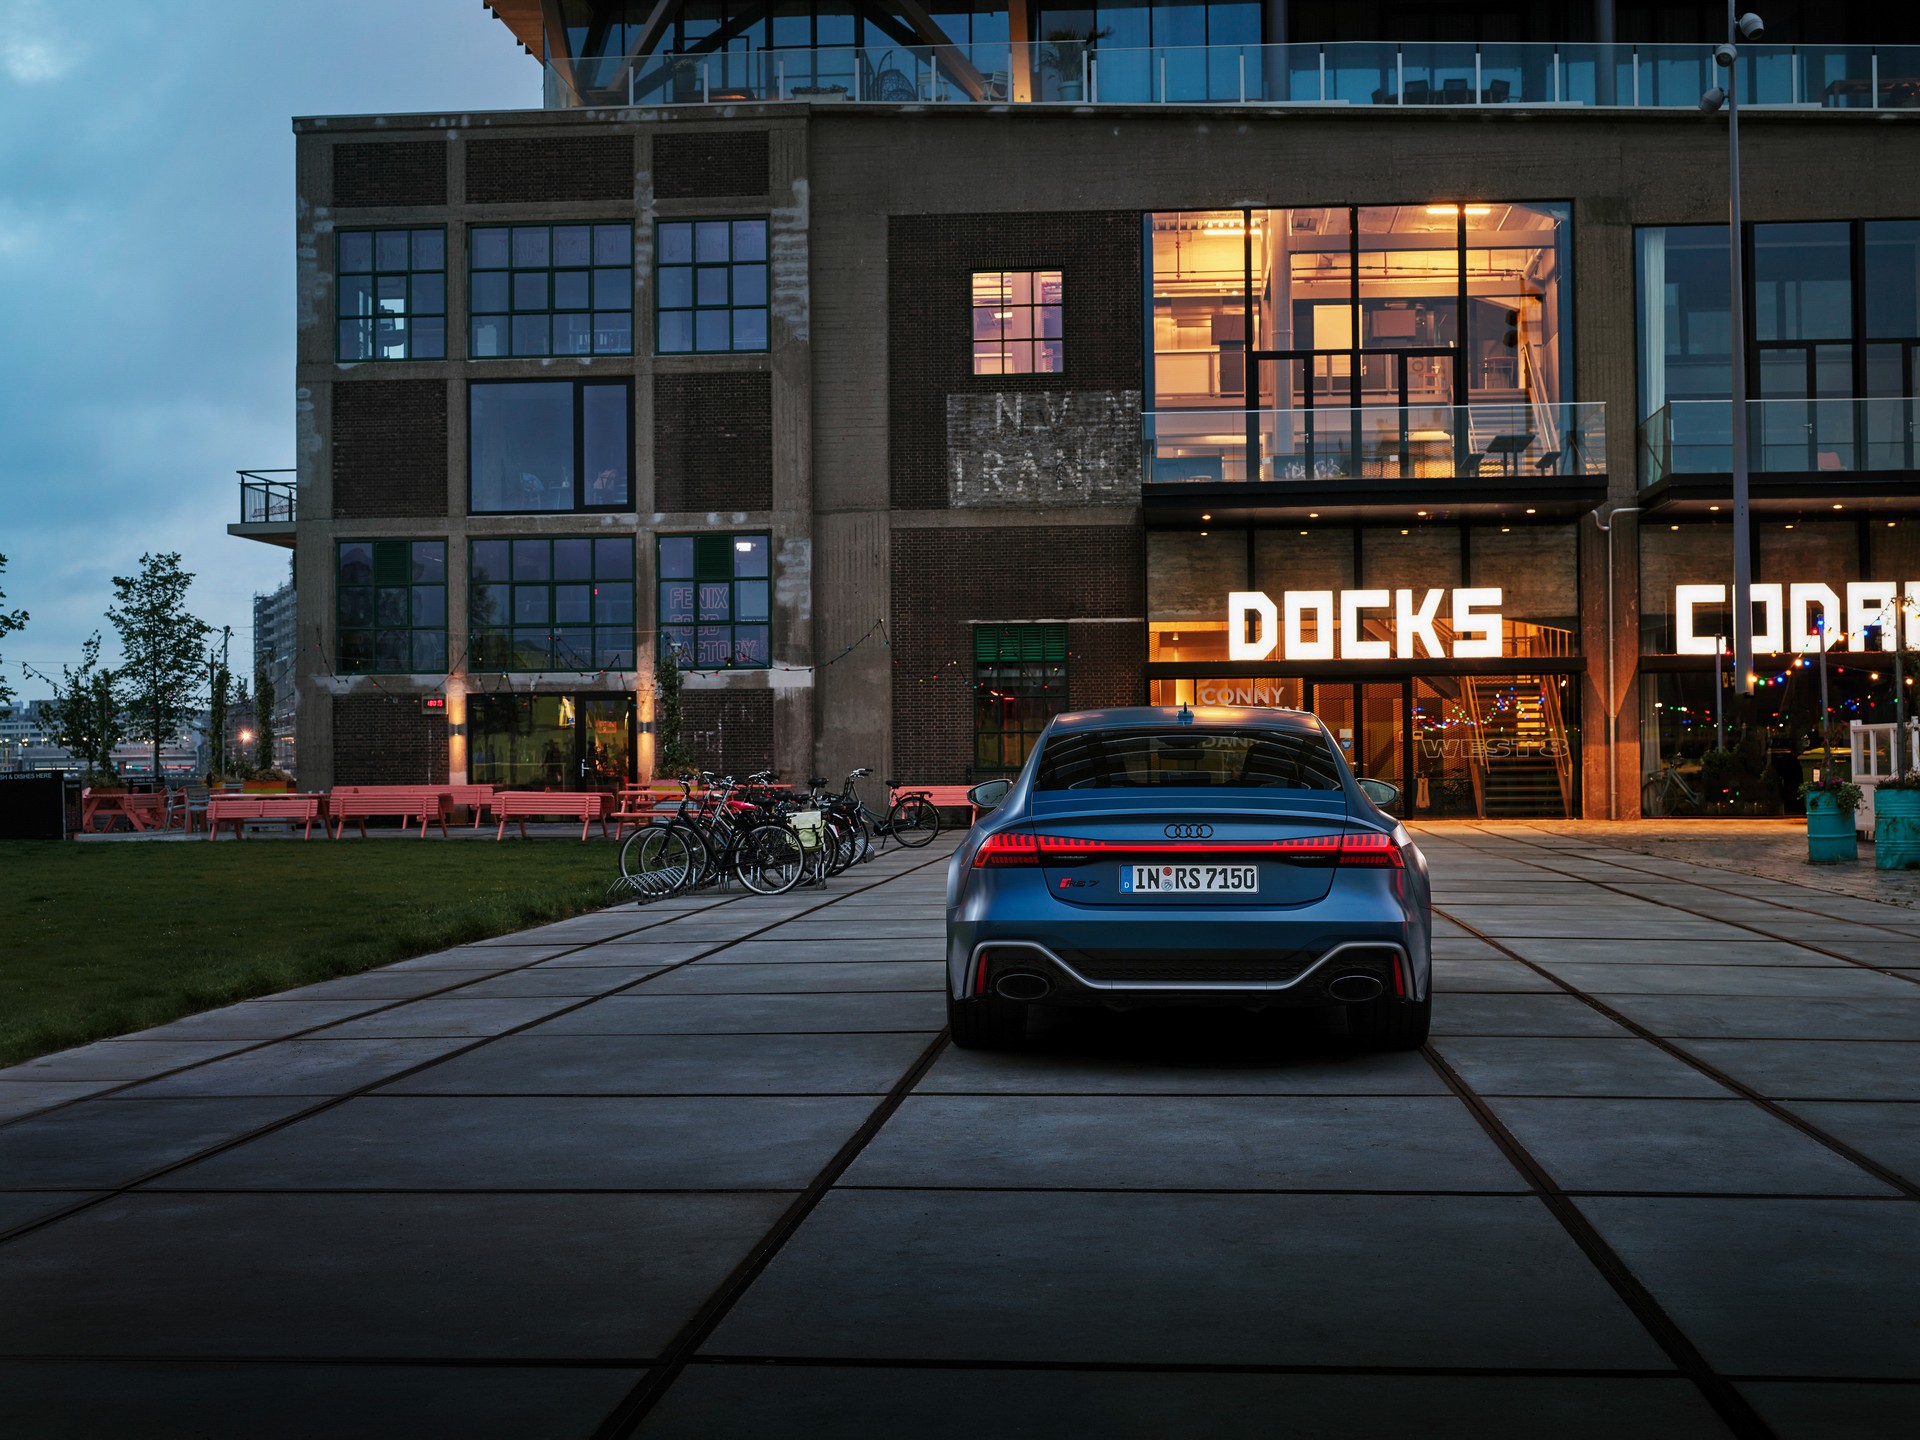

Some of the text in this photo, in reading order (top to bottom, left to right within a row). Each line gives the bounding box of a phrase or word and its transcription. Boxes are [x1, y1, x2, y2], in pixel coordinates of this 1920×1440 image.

[669, 587, 729, 609] FENIX
[1228, 587, 1502, 661] DOCKS
[669, 640, 757, 663] ACTORY
[1201, 686, 1285, 705] CONNY
[1124, 868, 1255, 889] D IN RS 7150
